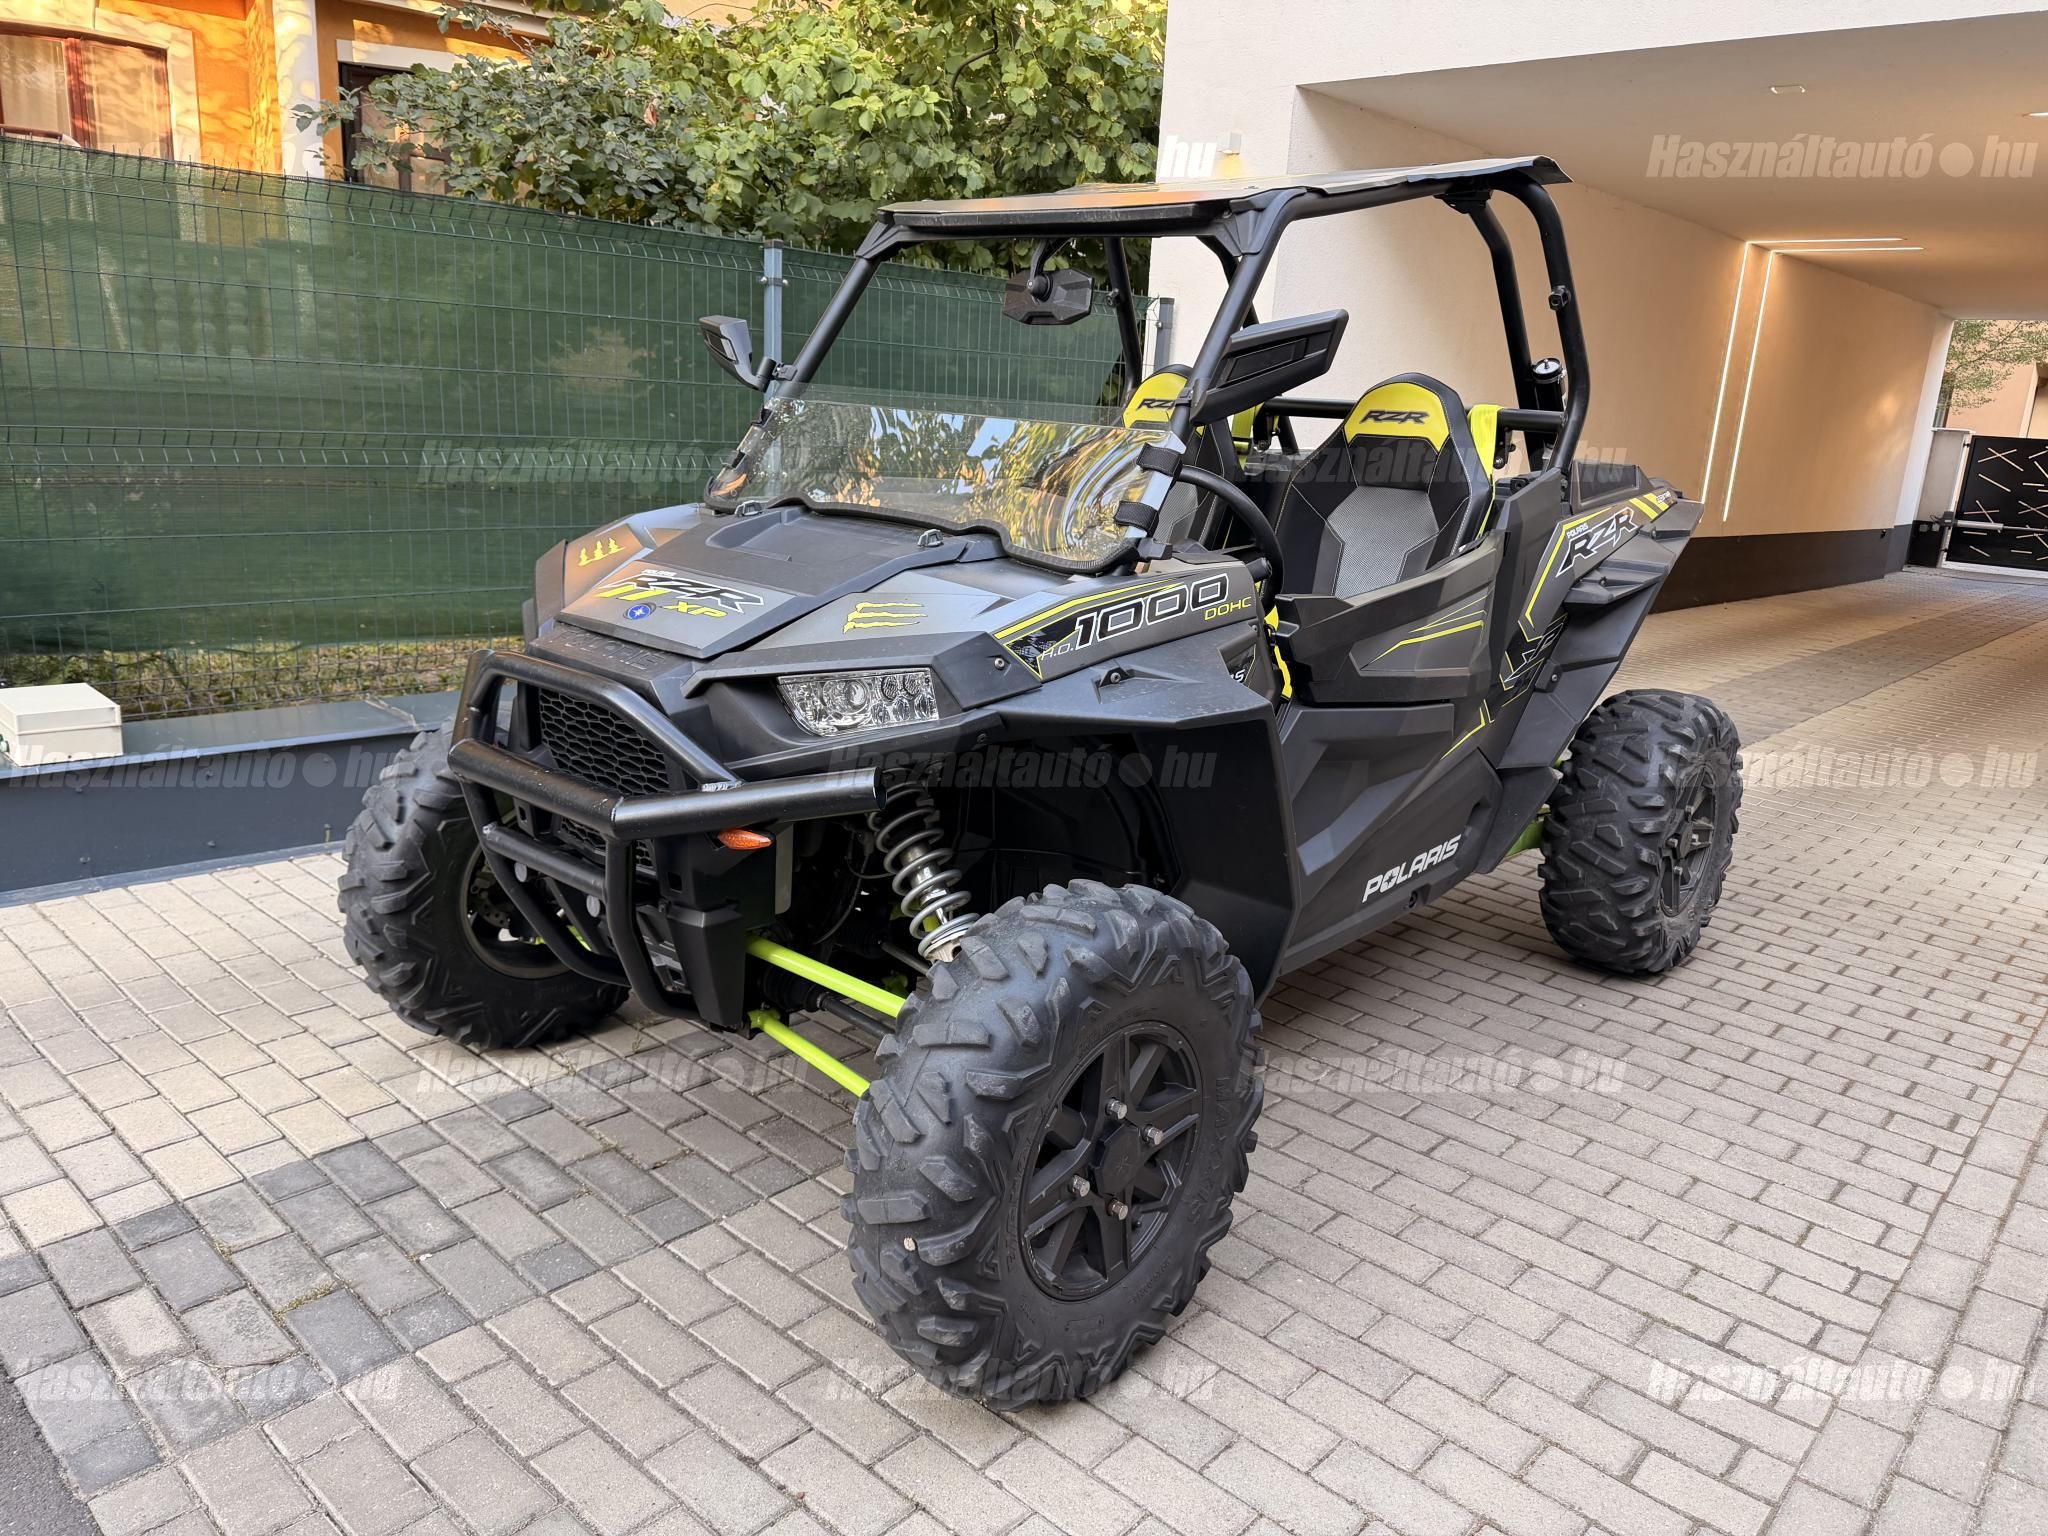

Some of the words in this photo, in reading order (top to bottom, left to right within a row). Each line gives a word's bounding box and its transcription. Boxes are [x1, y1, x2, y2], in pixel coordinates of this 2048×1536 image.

[1137, 398, 1175, 411] RZ
[1359, 409, 1429, 425] RZR
[1555, 506, 1638, 578] RZR
[1566, 522, 1589, 538] POLARIS
[600, 573, 765, 613] RZR
[661, 601, 728, 618] XP
[1075, 573, 1229, 650] 1000
[1204, 596, 1252, 621] DOHC
[1362, 833, 1462, 903] POLARIS
